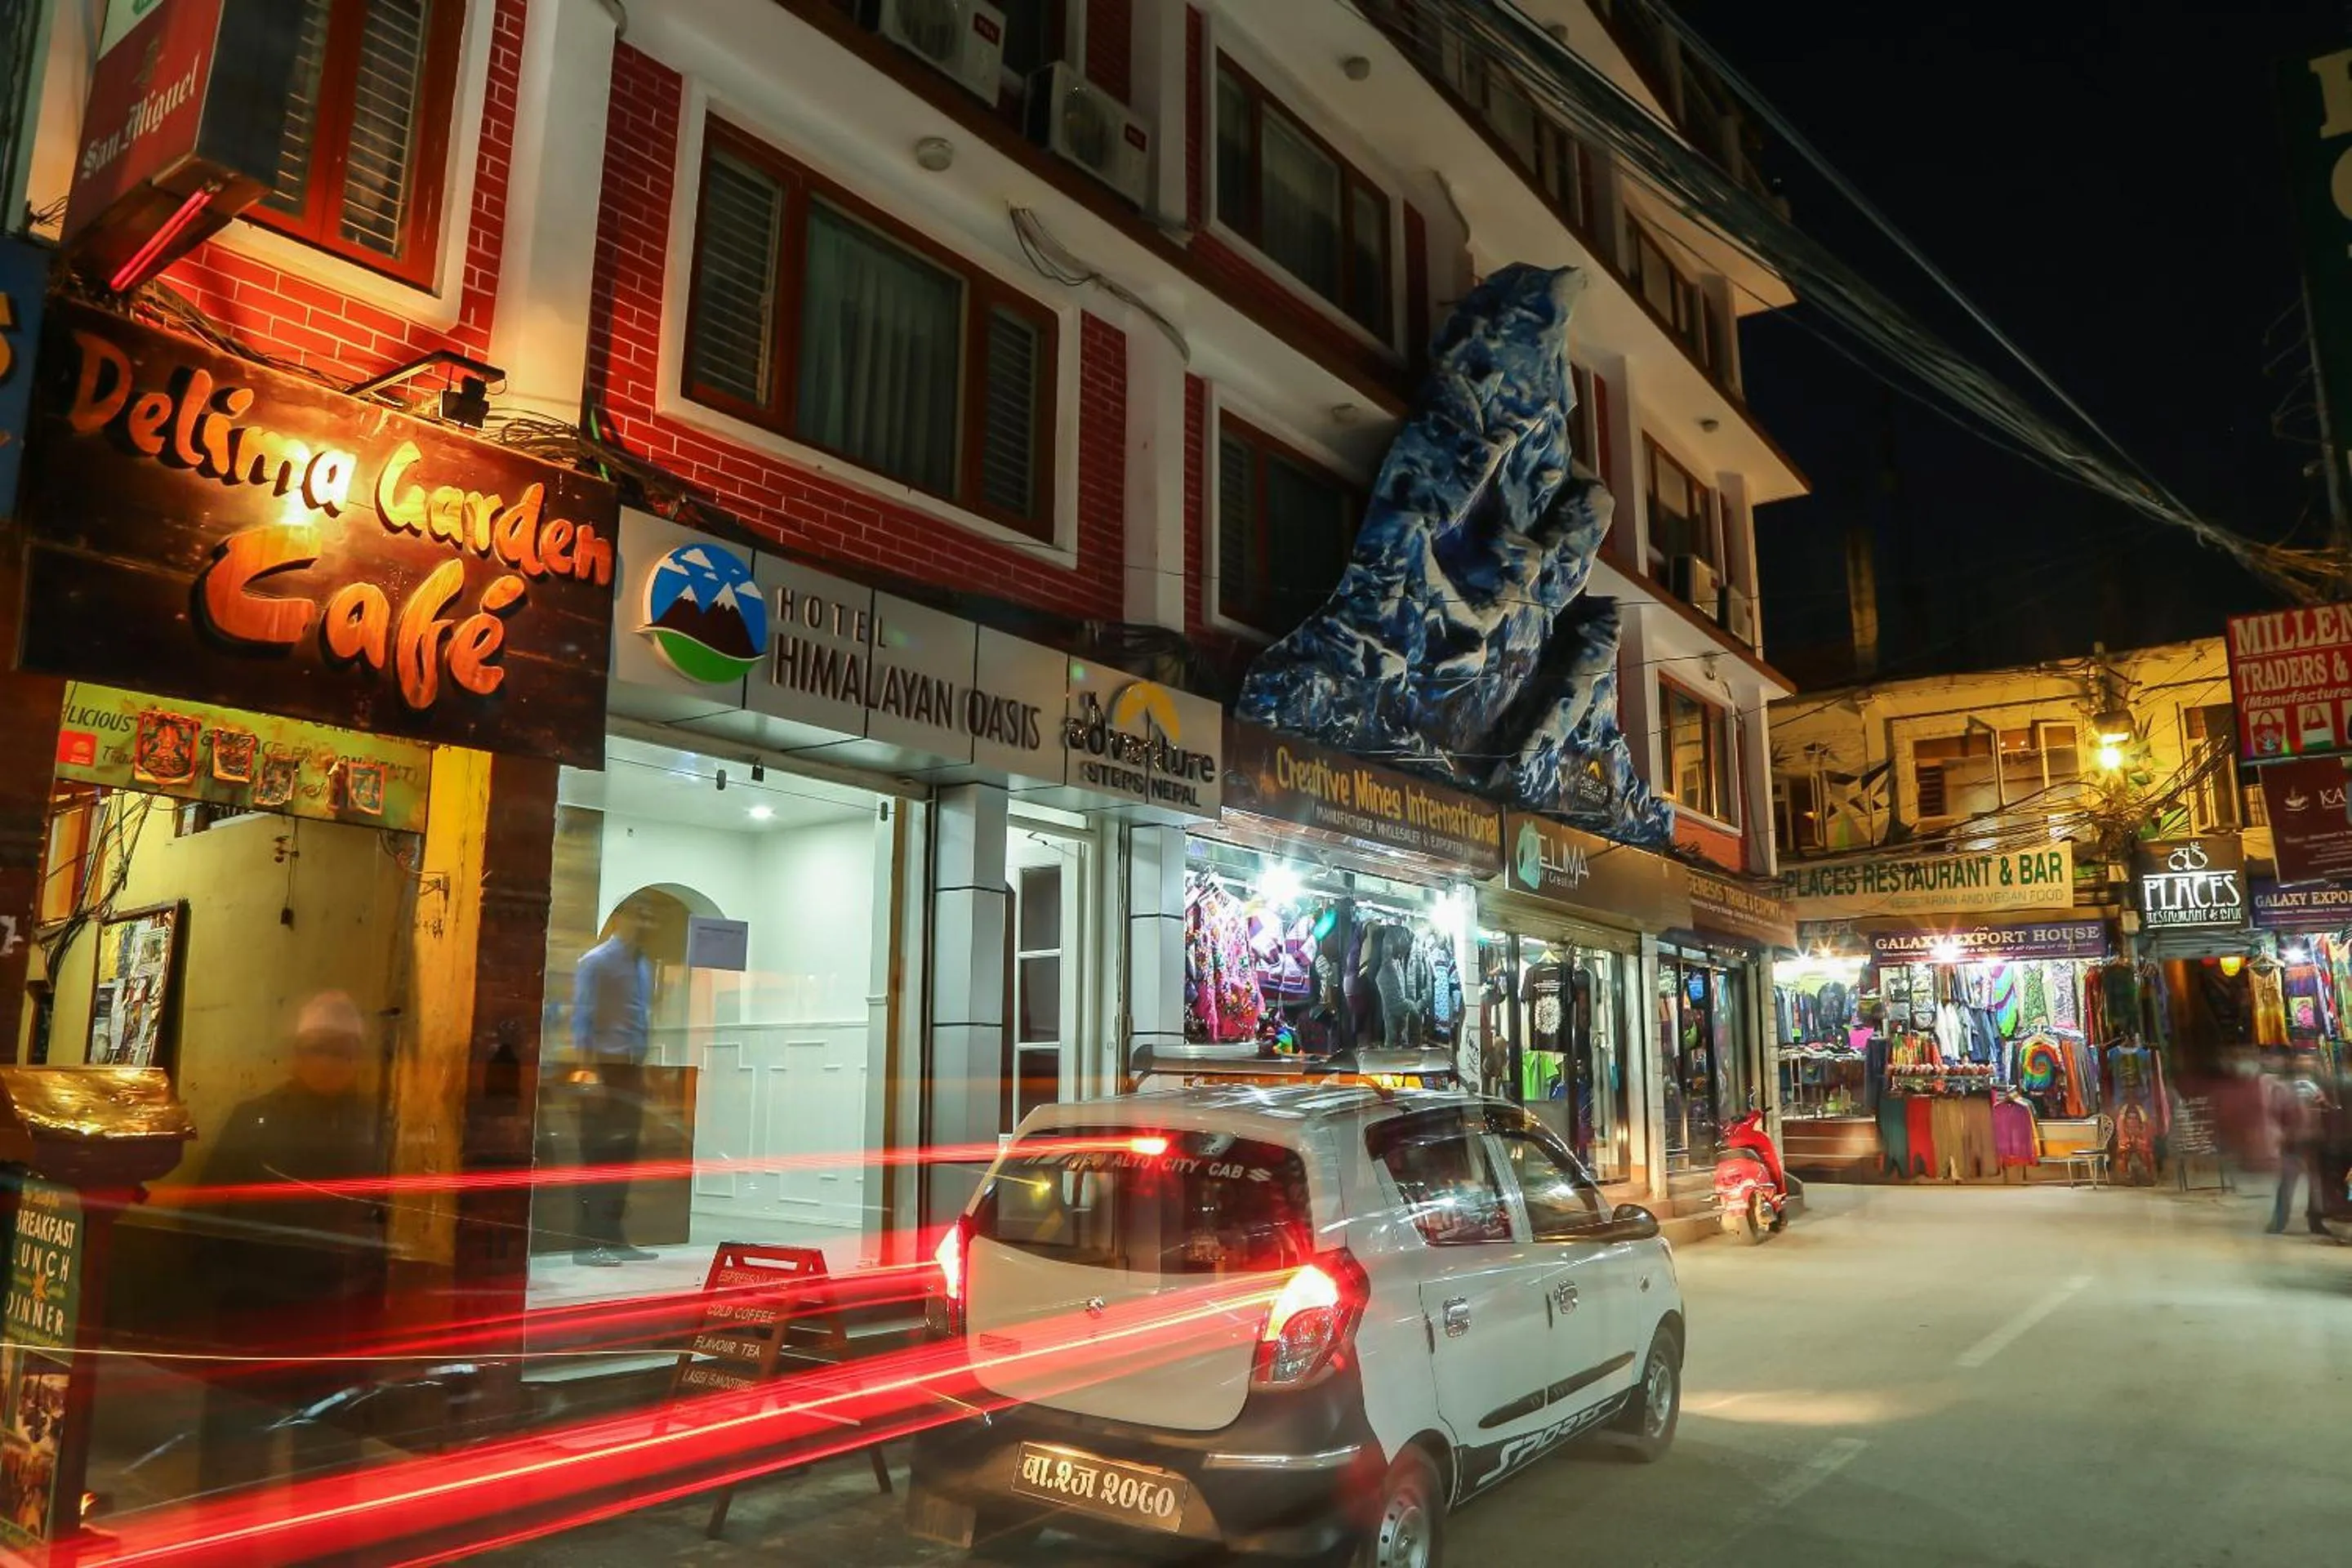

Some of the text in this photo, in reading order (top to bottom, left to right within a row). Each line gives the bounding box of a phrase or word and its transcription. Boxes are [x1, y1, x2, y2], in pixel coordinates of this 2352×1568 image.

[82, 49, 201, 179] San Miguel
[69, 332, 359, 517] Delima
[378, 441, 612, 586] Garden
[204, 525, 527, 710] Café
[777, 586, 886, 648] HOTEL
[772, 633, 1041, 751] HIMALAYAN OASIS
[2238, 650, 2349, 694] TRADERS &
[67, 705, 134, 733] LICIOUS
[1080, 760, 1201, 808] STEPS NEPAL
[1276, 746, 1500, 847] Creative Mines International
[1784, 865, 1857, 898] PLACES
[1862, 858, 1993, 894] RESTAURANT
[1998, 855, 2013, 886] &
[2019, 852, 2064, 884] BAR
[1961, 893, 1984, 905] AND
[1988, 890, 2027, 904] VEGAN
[2029, 888, 2065, 902] FOOD
[2143, 874, 2240, 911] PLACES
[2255, 891, 2308, 908] GALAXY
[2033, 925, 2100, 942] HOUSE
[1161, 1157, 1202, 1174] CITY
[1209, 1163, 1245, 1180] CAB
[12, 1243, 70, 1282] UNCH
[693, 1334, 760, 1358] FLAVOUR TEA
